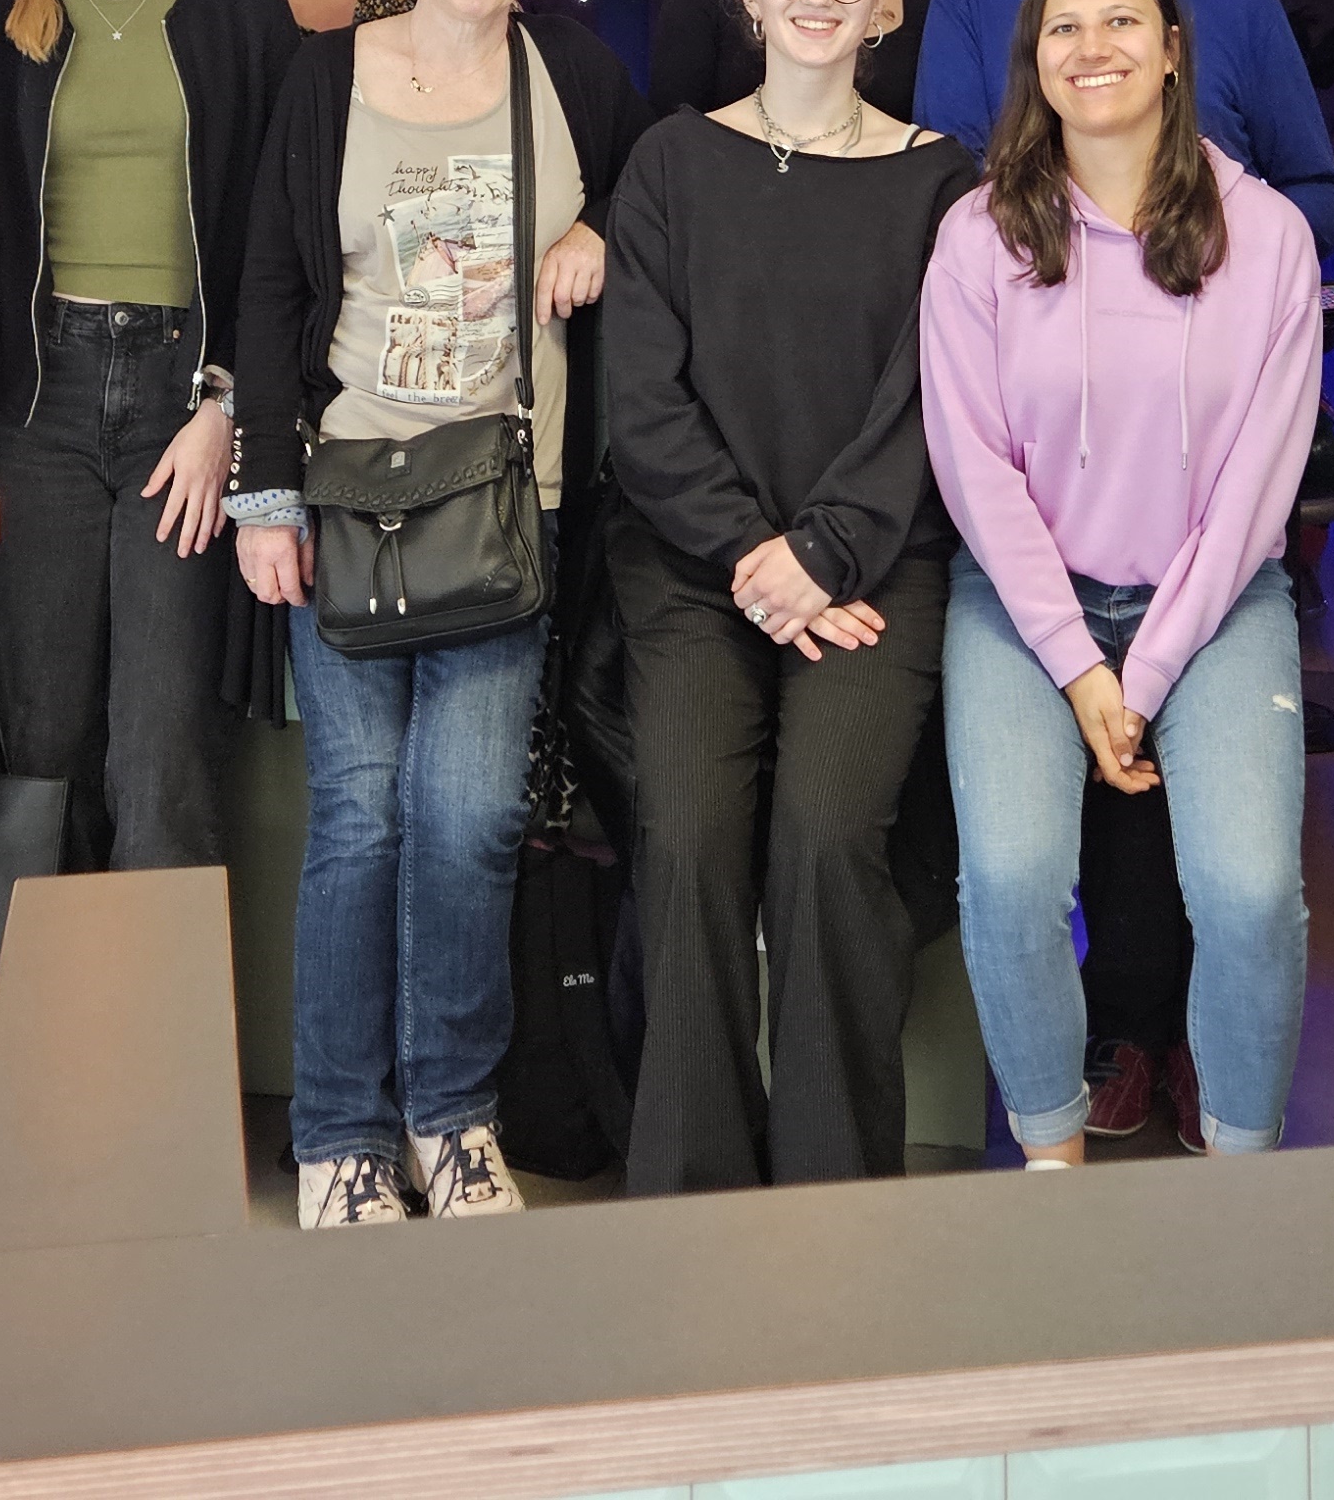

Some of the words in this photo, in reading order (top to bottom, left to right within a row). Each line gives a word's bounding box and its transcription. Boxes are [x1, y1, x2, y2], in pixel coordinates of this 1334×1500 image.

[392, 161, 438, 183] happy
[382, 388, 398, 399] feel
[408, 392, 426, 402] the
